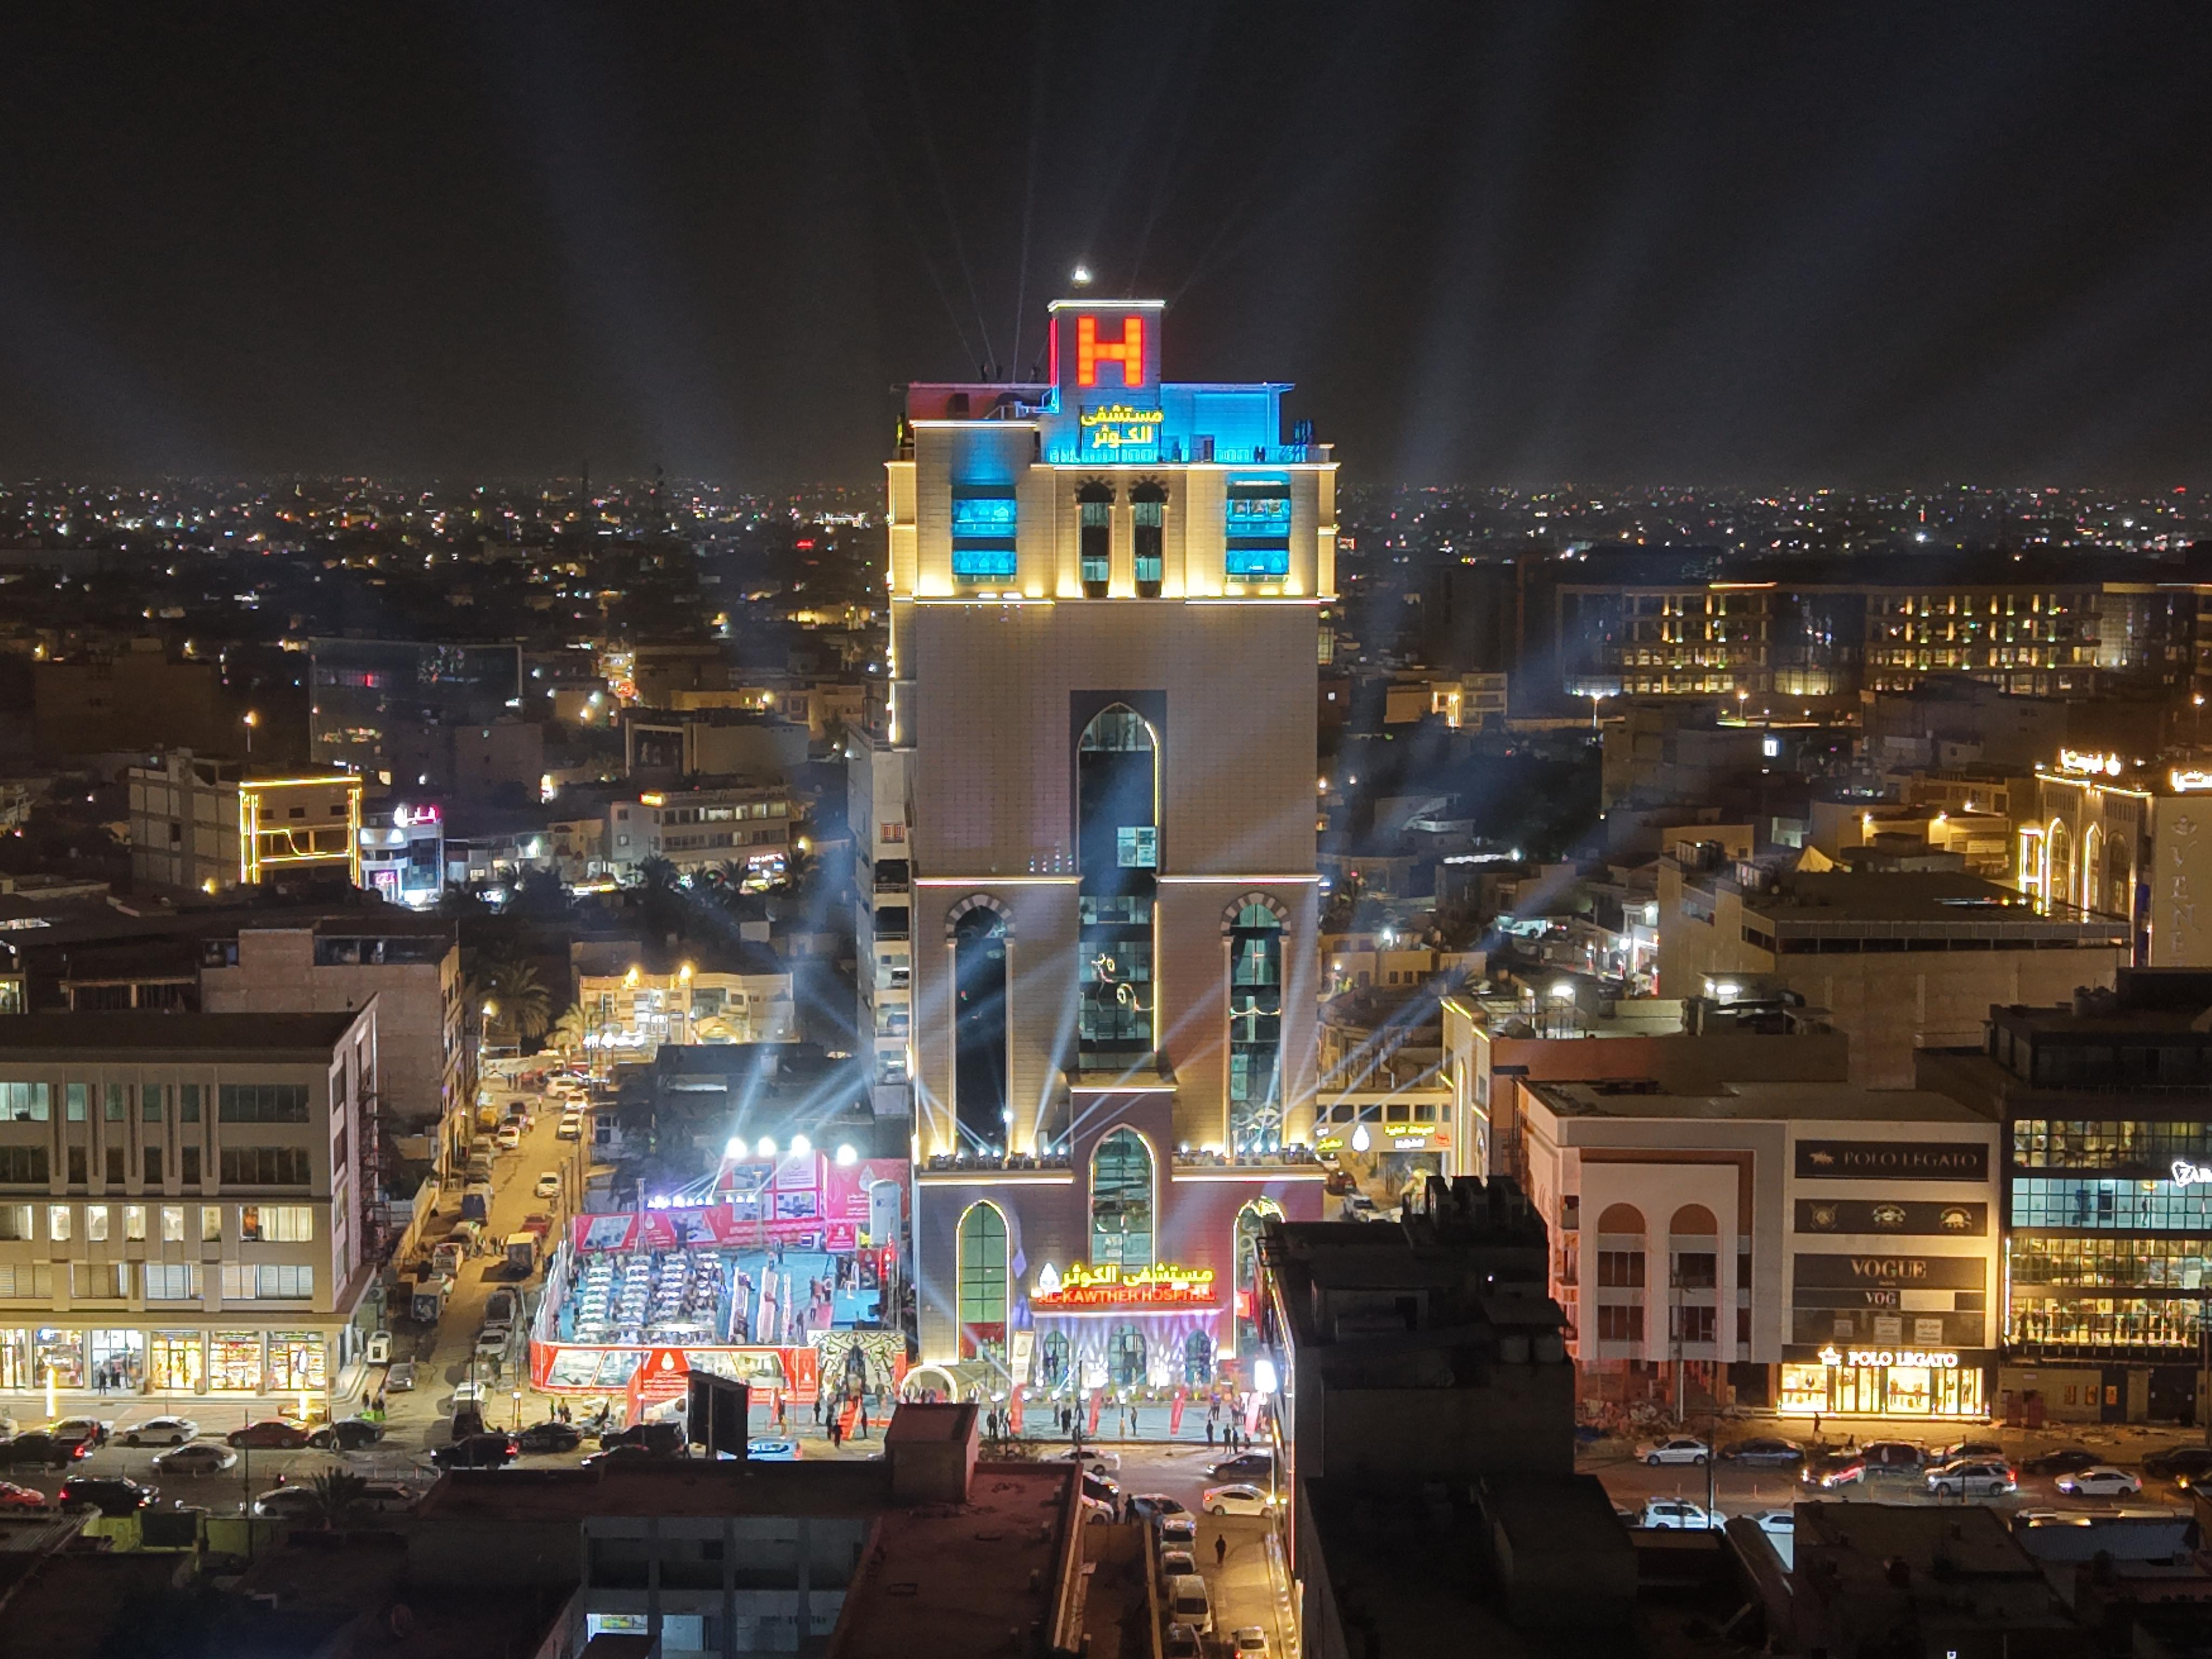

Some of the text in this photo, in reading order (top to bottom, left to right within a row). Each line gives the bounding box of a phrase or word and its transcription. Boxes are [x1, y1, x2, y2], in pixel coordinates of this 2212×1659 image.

[1076, 316, 1144, 387] H
[1081, 404, 1163, 426] مستشفى
[1091, 423, 1153, 449] الكوثر
[1844, 1151, 1977, 1167] POLO LEGATO
[1061, 1262, 1213, 1289] مستشفى الكوثر
[1850, 1259, 1927, 1278] VOGUE
[1038, 1287, 1216, 1304] AL-KAWTHER HOSPITAL
[1848, 1351, 1958, 1368] POLO LEGATO
